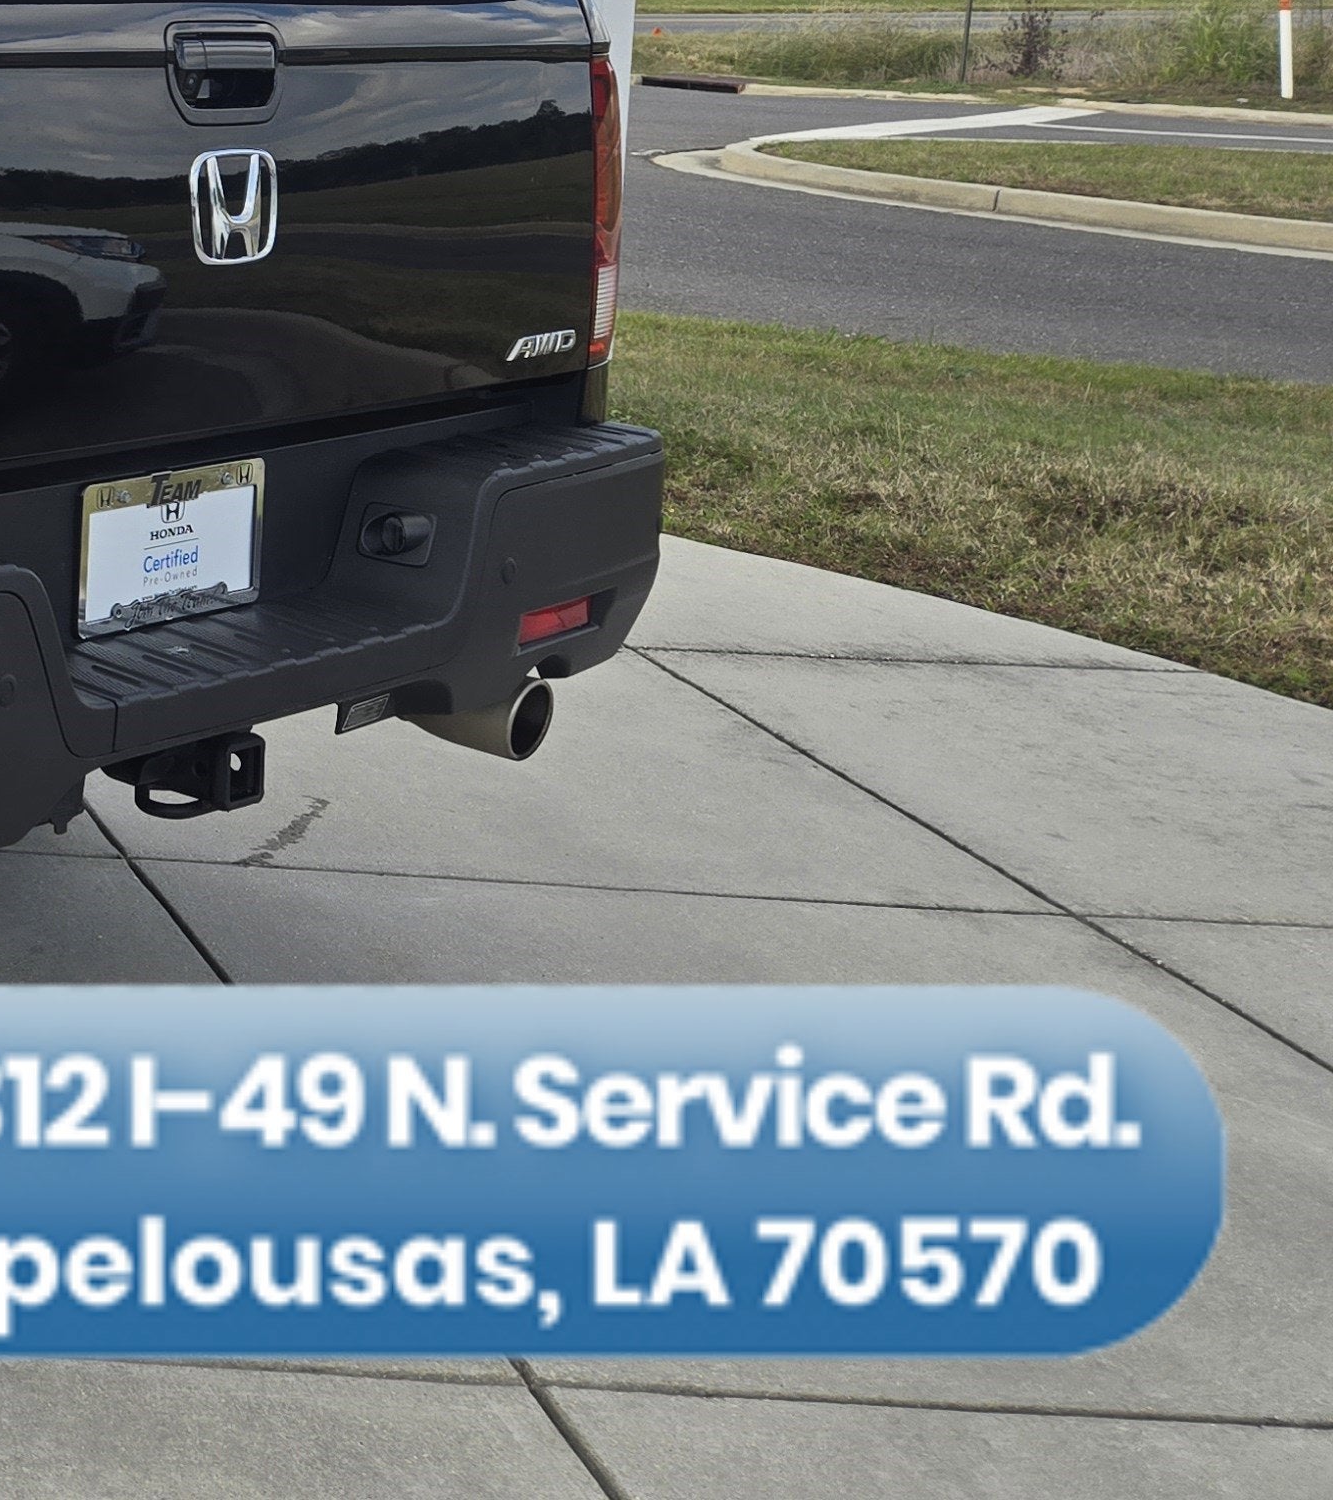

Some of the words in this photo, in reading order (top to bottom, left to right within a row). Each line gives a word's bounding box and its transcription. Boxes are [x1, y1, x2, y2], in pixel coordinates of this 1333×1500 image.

[505, 329, 576, 361] AWD
[149, 524, 194, 541] HONDA
[143, 546, 199, 574] Certified
[143, 567, 198, 587] Pre-Owned
